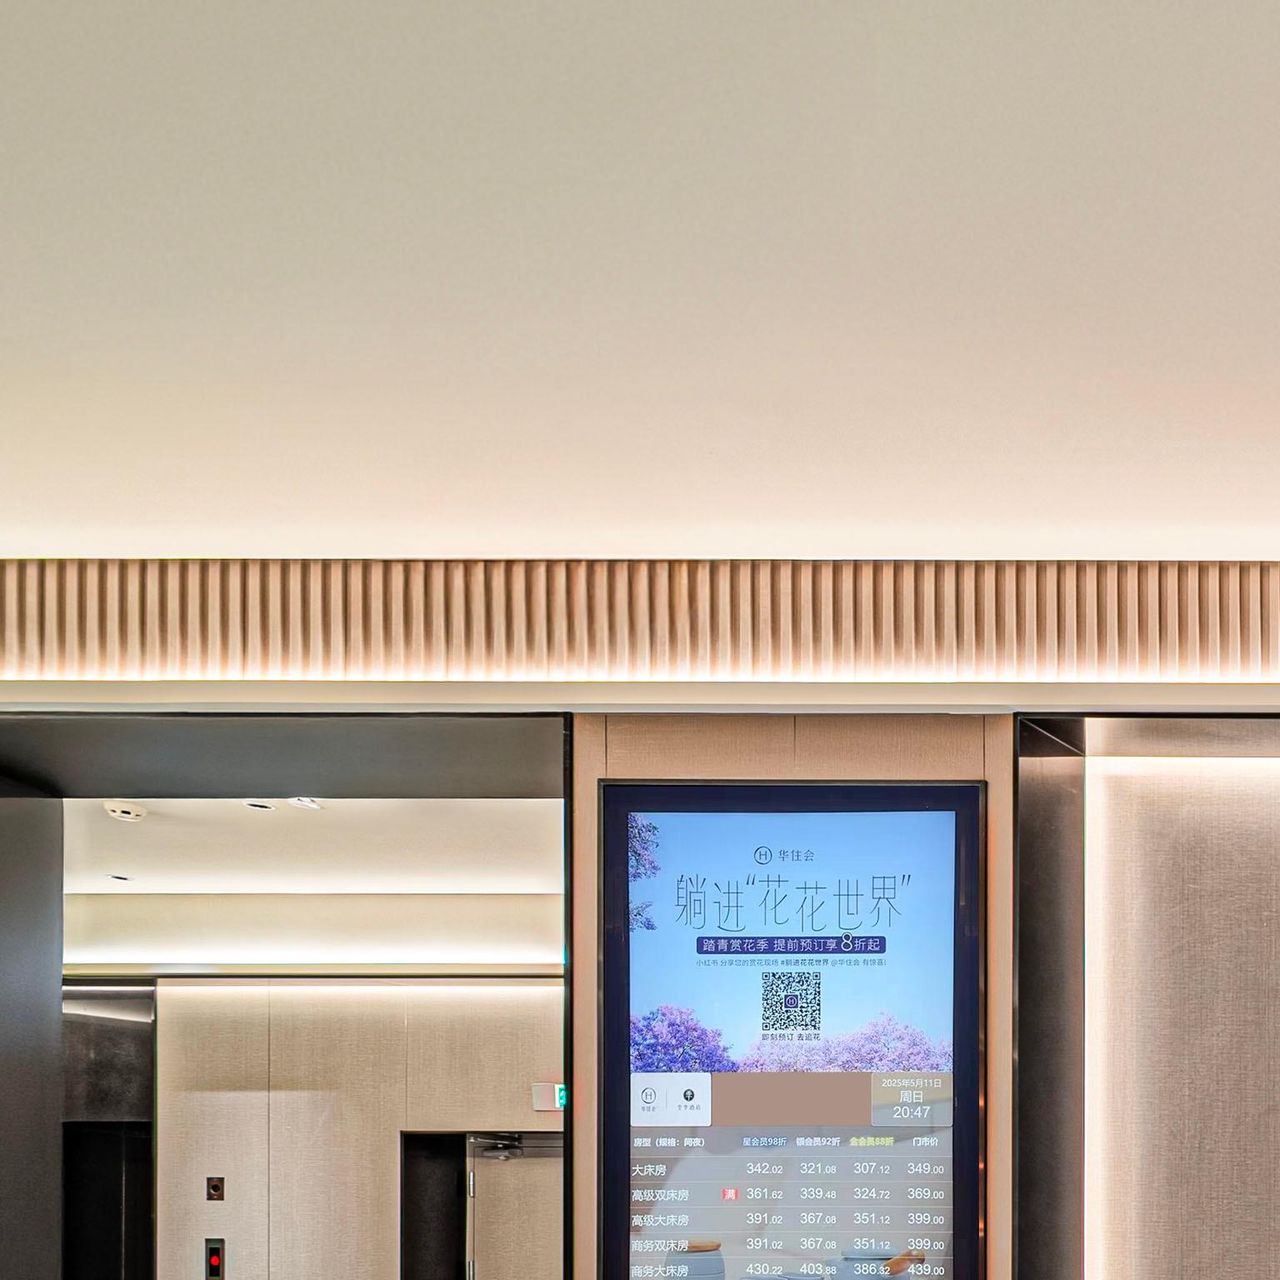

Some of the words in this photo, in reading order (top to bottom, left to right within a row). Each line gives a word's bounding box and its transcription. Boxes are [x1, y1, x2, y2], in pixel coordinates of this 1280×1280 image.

[778, 849, 815, 862] 华住会
[702, 938, 769, 952] 踏青赏花季
[773, 932, 881, 952] 提前预订享8折起
[761, 1033, 794, 1041] 即刻预订
[881, 1078, 942, 1088] 2025年5月11日
[899, 1090, 923, 1103] 周日
[893, 1106, 931, 1119] 20:47
[743, 1137, 787, 1147] 星会员98折
[912, 1136, 939, 1147] 门市价
[631, 1164, 667, 1177] 大床房
[746, 1162, 783, 1174] 342.02
[800, 1162, 837, 1174] 321.08
[853, 1162, 891, 1174] 307.12
[907, 1162, 945, 1174] 349.00
[631, 1189, 690, 1202] 高级双床房
[746, 1187, 783, 1199] 361.62
[800, 1187, 837, 1199] 339.48
[853, 1187, 891, 1199] 324.72
[907, 1187, 945, 1199] 369.00
[631, 1214, 690, 1227] 高级大床房
[746, 1212, 783, 1224] 391.02
[800, 1212, 837, 1224] 367.08
[853, 1212, 891, 1224] 351.12
[907, 1212, 945, 1224] 399.00
[631, 1240, 689, 1252] 商务双床房
[746, 1237, 783, 1250] 391.02
[800, 1237, 837, 1250] 367.08
[853, 1237, 891, 1250] 351.12
[907, 1237, 945, 1250] 399.00
[631, 1265, 689, 1277] 商务大床房
[746, 1263, 783, 1275] 430.22
[800, 1263, 837, 1275] 403.88
[907, 1263, 945, 1275] 439.00
